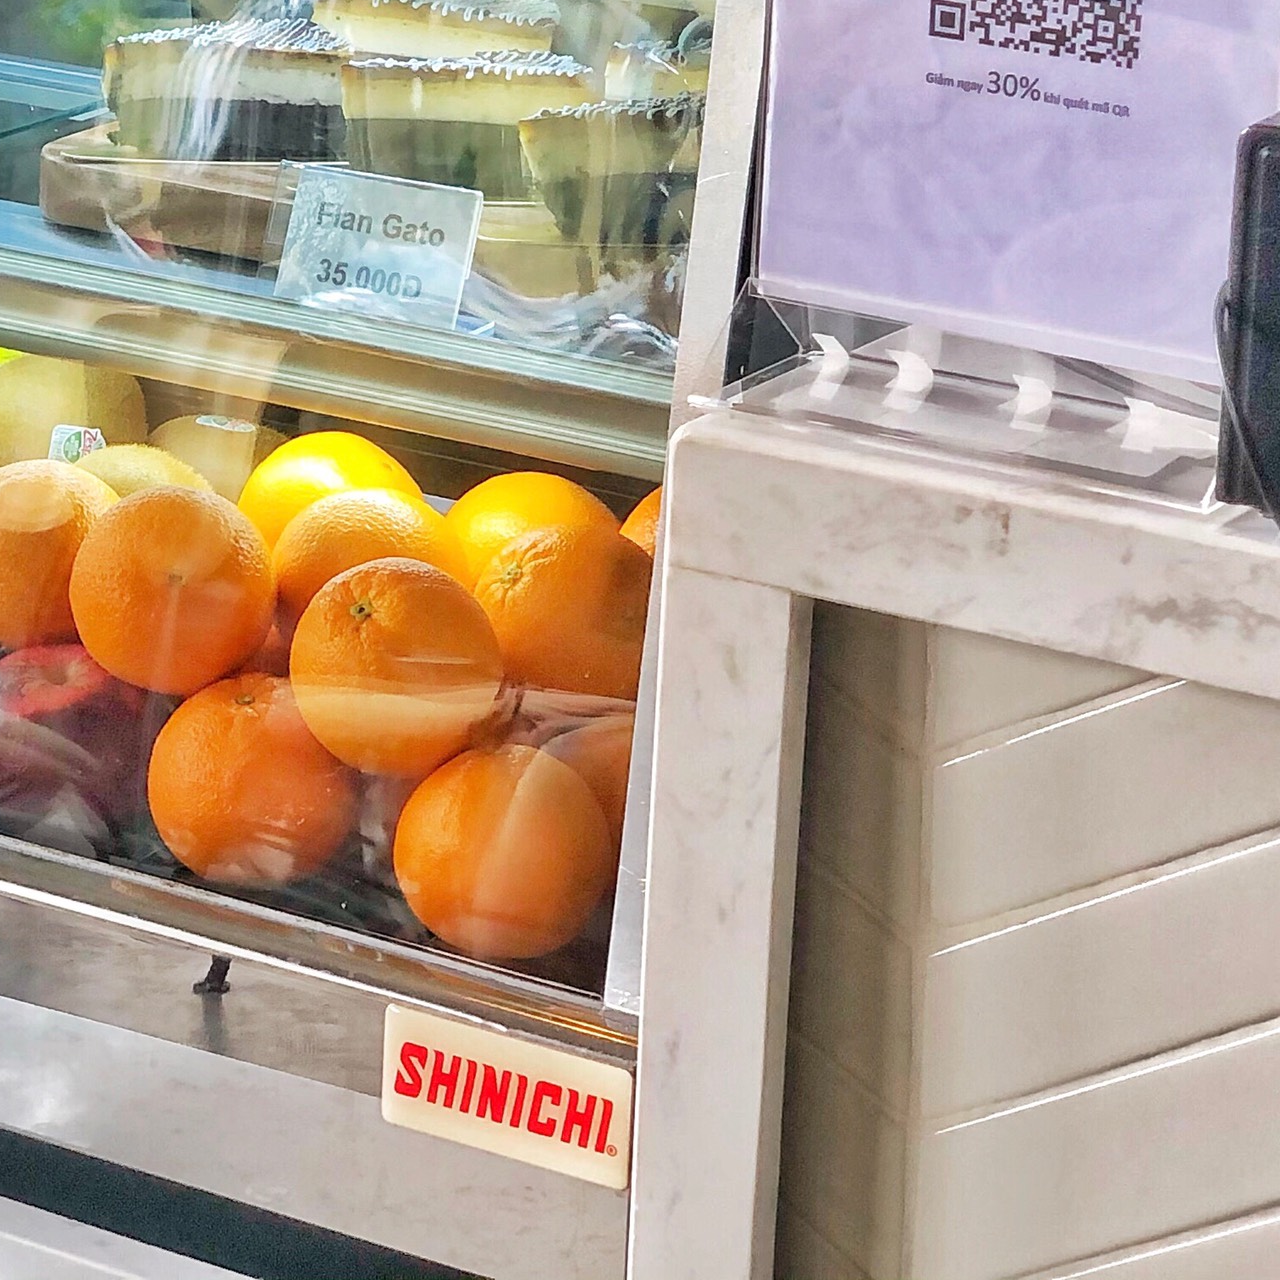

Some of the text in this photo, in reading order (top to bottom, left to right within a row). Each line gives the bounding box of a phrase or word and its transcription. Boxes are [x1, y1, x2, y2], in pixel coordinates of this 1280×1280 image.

[957, 80, 983, 93] ngay
[987, 71, 1041, 101] 30%
[1044, 92, 1060, 104] khi
[1063, 98, 1089, 110] quét
[1112, 104, 1130, 117] QR
[383, 214, 445, 246] Gato
[394, 1042, 614, 1153] SHINICHI
